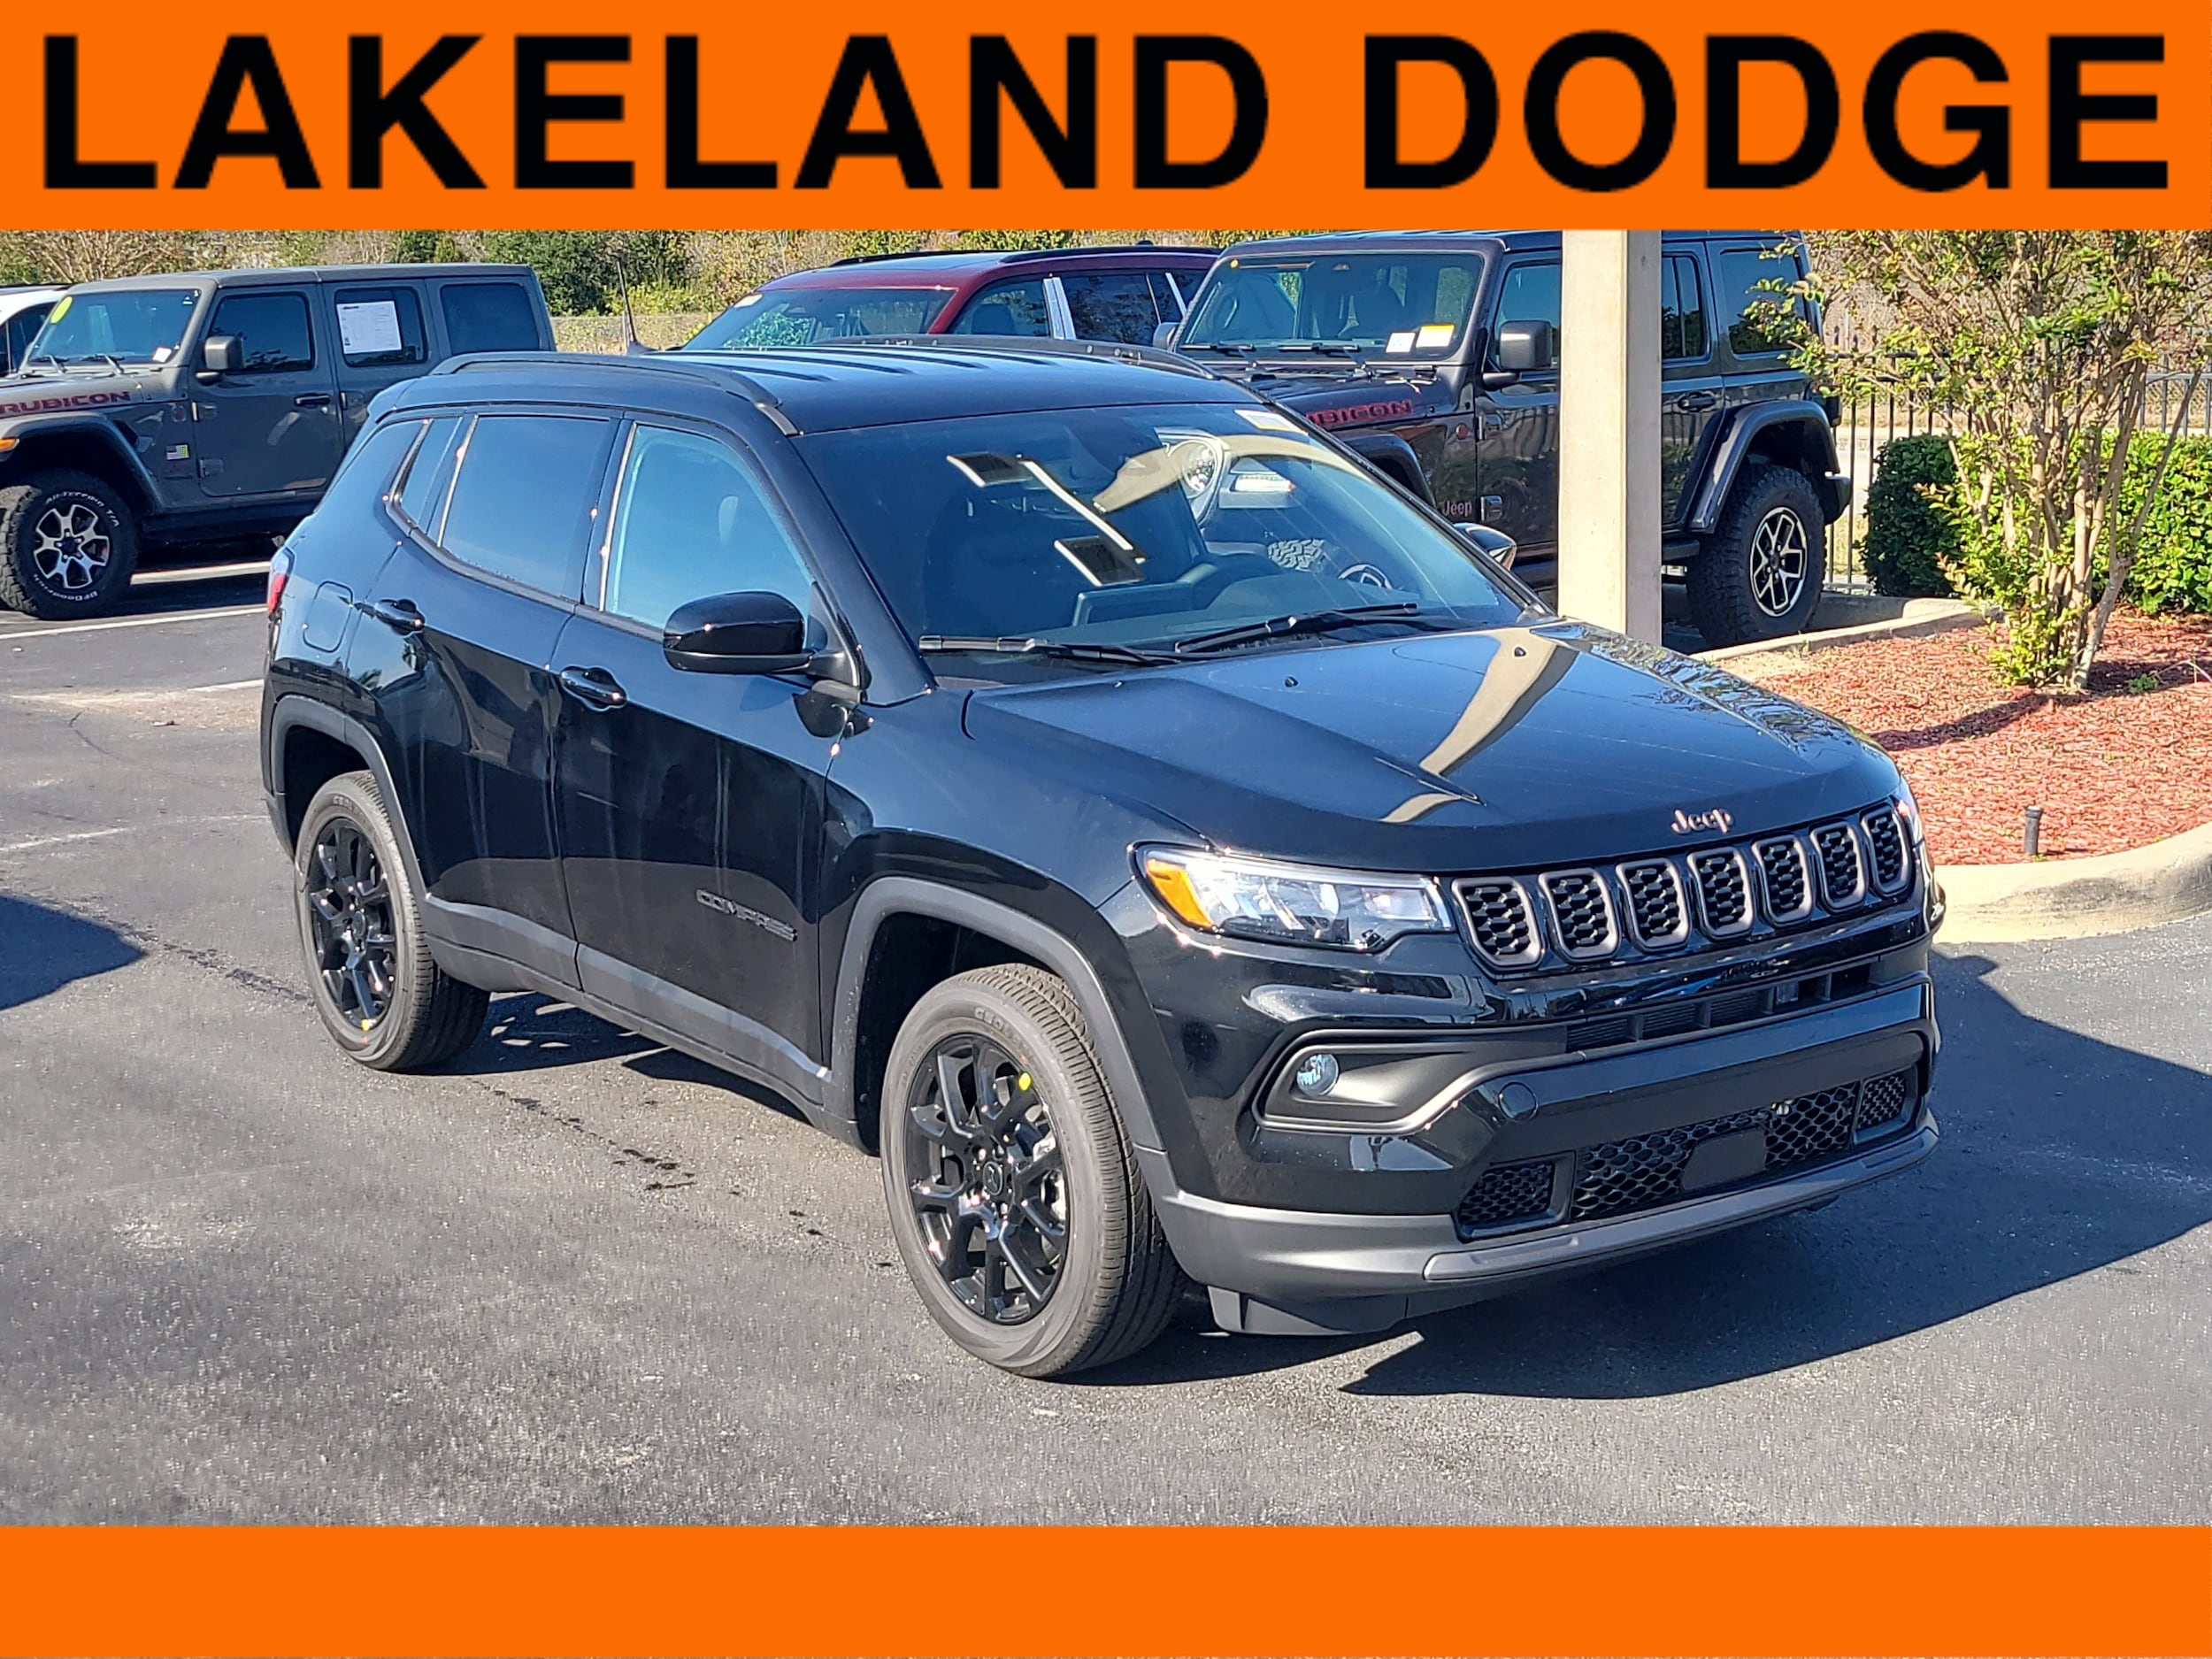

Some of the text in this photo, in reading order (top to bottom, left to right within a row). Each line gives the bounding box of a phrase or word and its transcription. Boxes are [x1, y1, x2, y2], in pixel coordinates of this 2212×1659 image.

[0, 391, 131, 415] RUBICON
[1440, 499, 1473, 518] Jeep
[1670, 808, 1734, 835] Jeep
